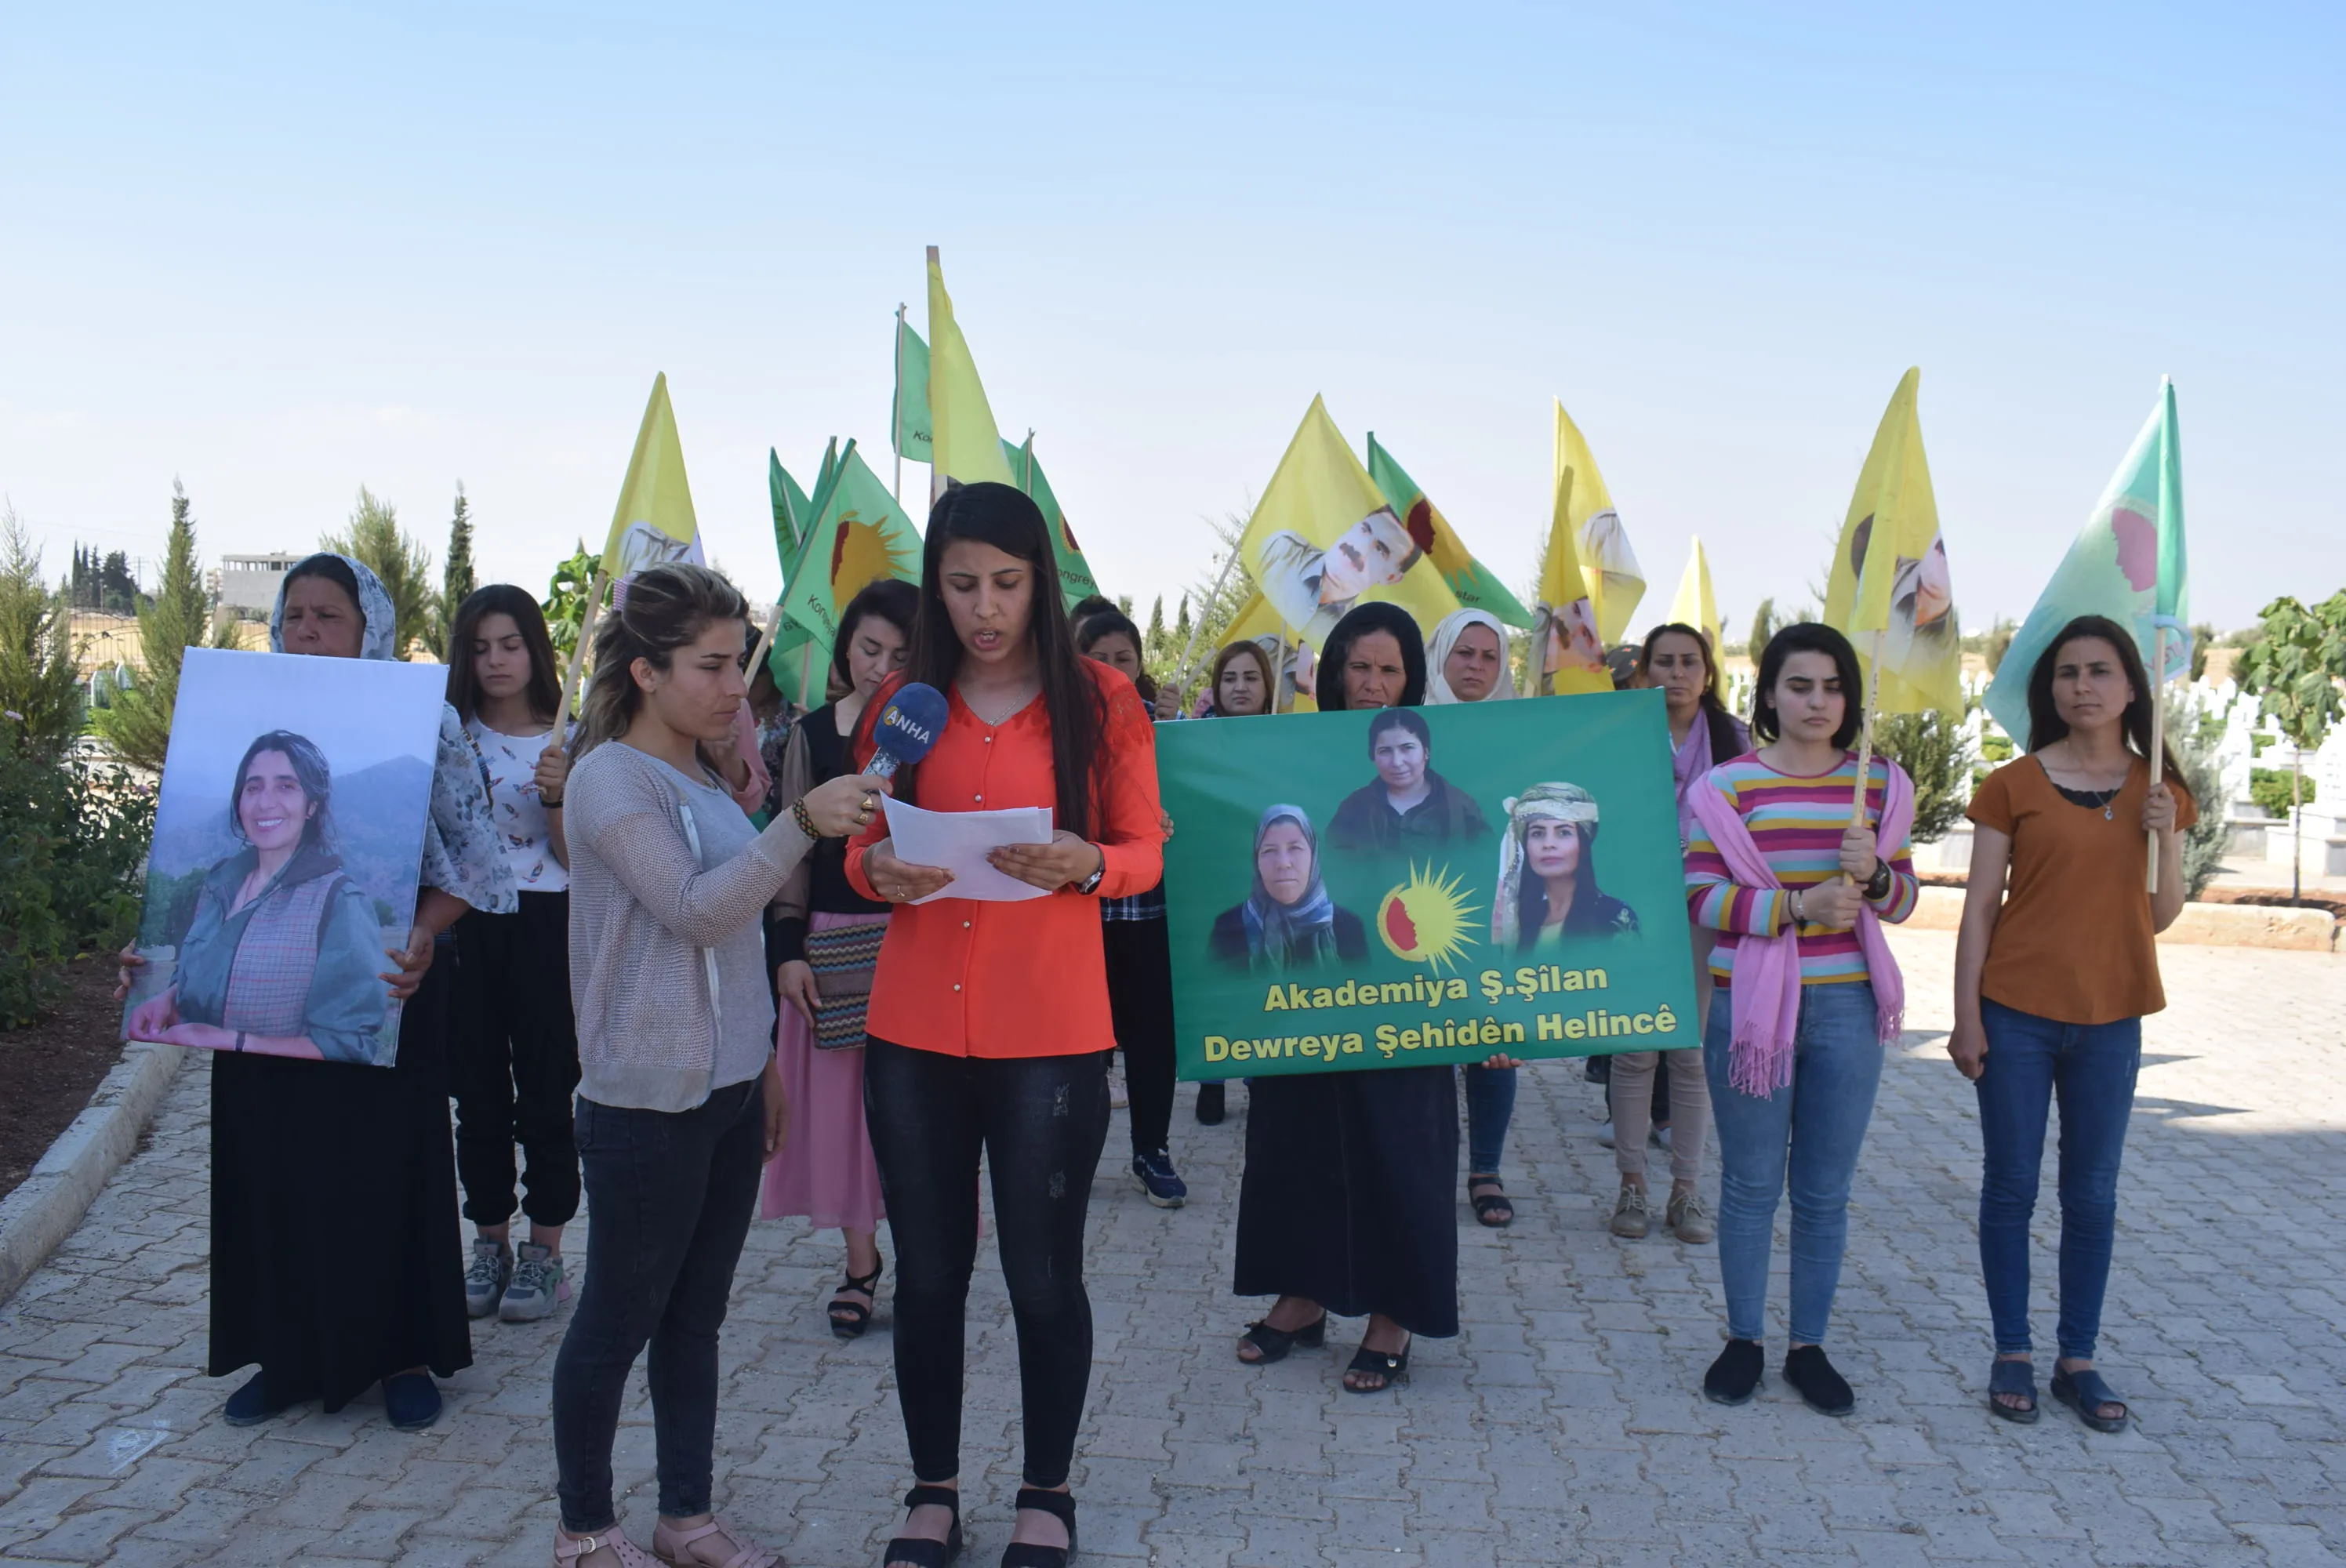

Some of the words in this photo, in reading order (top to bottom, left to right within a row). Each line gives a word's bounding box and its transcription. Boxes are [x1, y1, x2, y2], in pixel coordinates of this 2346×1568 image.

[887, 710, 930, 744] ANHA
[1263, 974, 1469, 1011] Akademiya
[1480, 964, 1608, 1004] Ş.Şîlan
[1204, 1031, 1364, 1062] Dewreya
[1375, 1016, 1525, 1058] Şehîdên
[1536, 1003, 1677, 1041] Helincê
